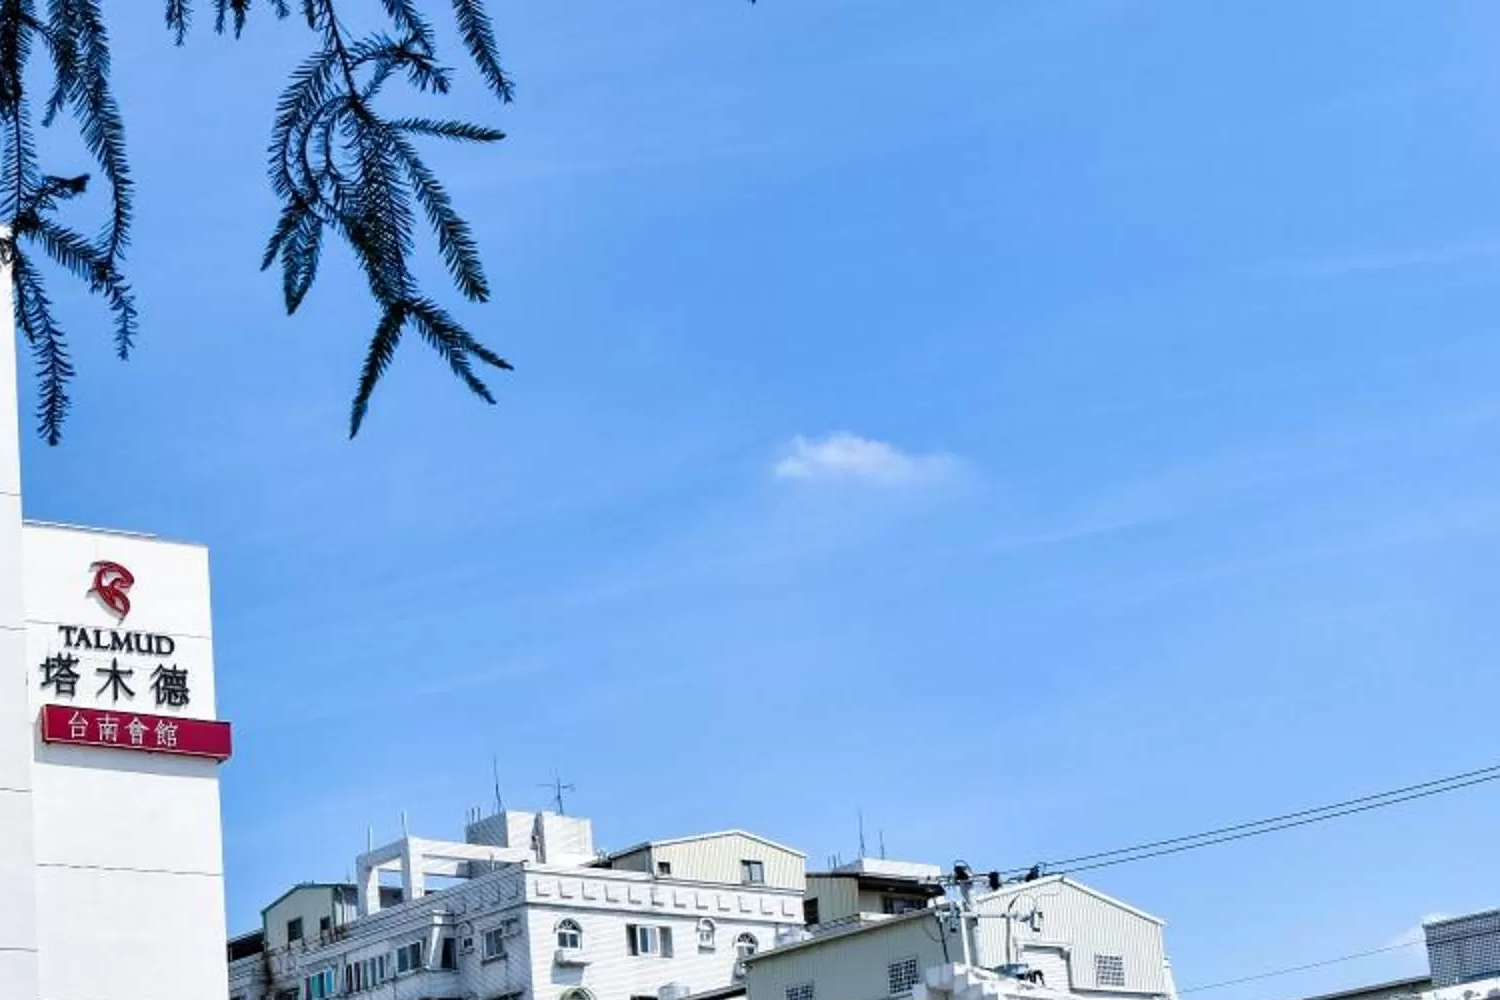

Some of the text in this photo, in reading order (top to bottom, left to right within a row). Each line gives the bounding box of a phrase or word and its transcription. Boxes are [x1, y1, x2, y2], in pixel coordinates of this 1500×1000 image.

[59, 625, 175, 655] TALMUD
[40, 652, 190, 707] 塔木德
[67, 711, 179, 747] 台南會館
